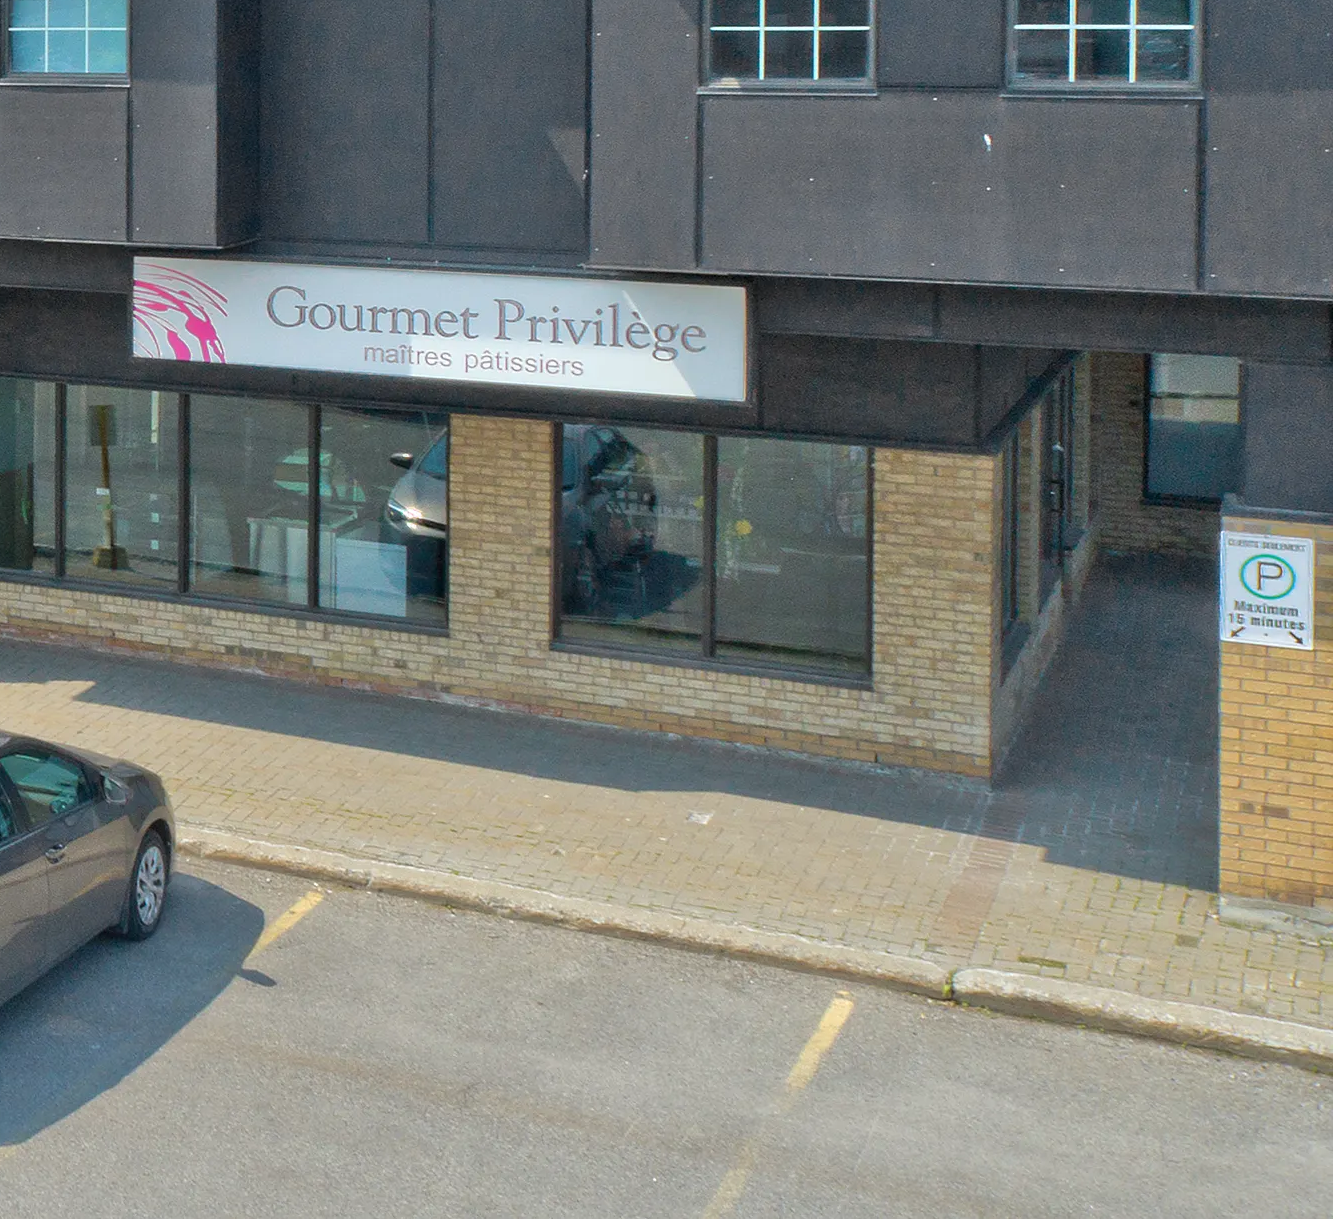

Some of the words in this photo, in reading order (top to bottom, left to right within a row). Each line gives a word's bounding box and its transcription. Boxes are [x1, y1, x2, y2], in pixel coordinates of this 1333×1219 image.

[265, 284, 480, 341] Gourmet
[493, 297, 708, 361] Privilège
[364, 342, 453, 369] maîtres
[464, 347, 585, 377] pâtissiers
[1256, 561, 1283, 591] P
[1229, 612, 1245, 624] 15
[1250, 616, 1305, 631] minutes
[1233, 599, 1299, 617] Maximum
